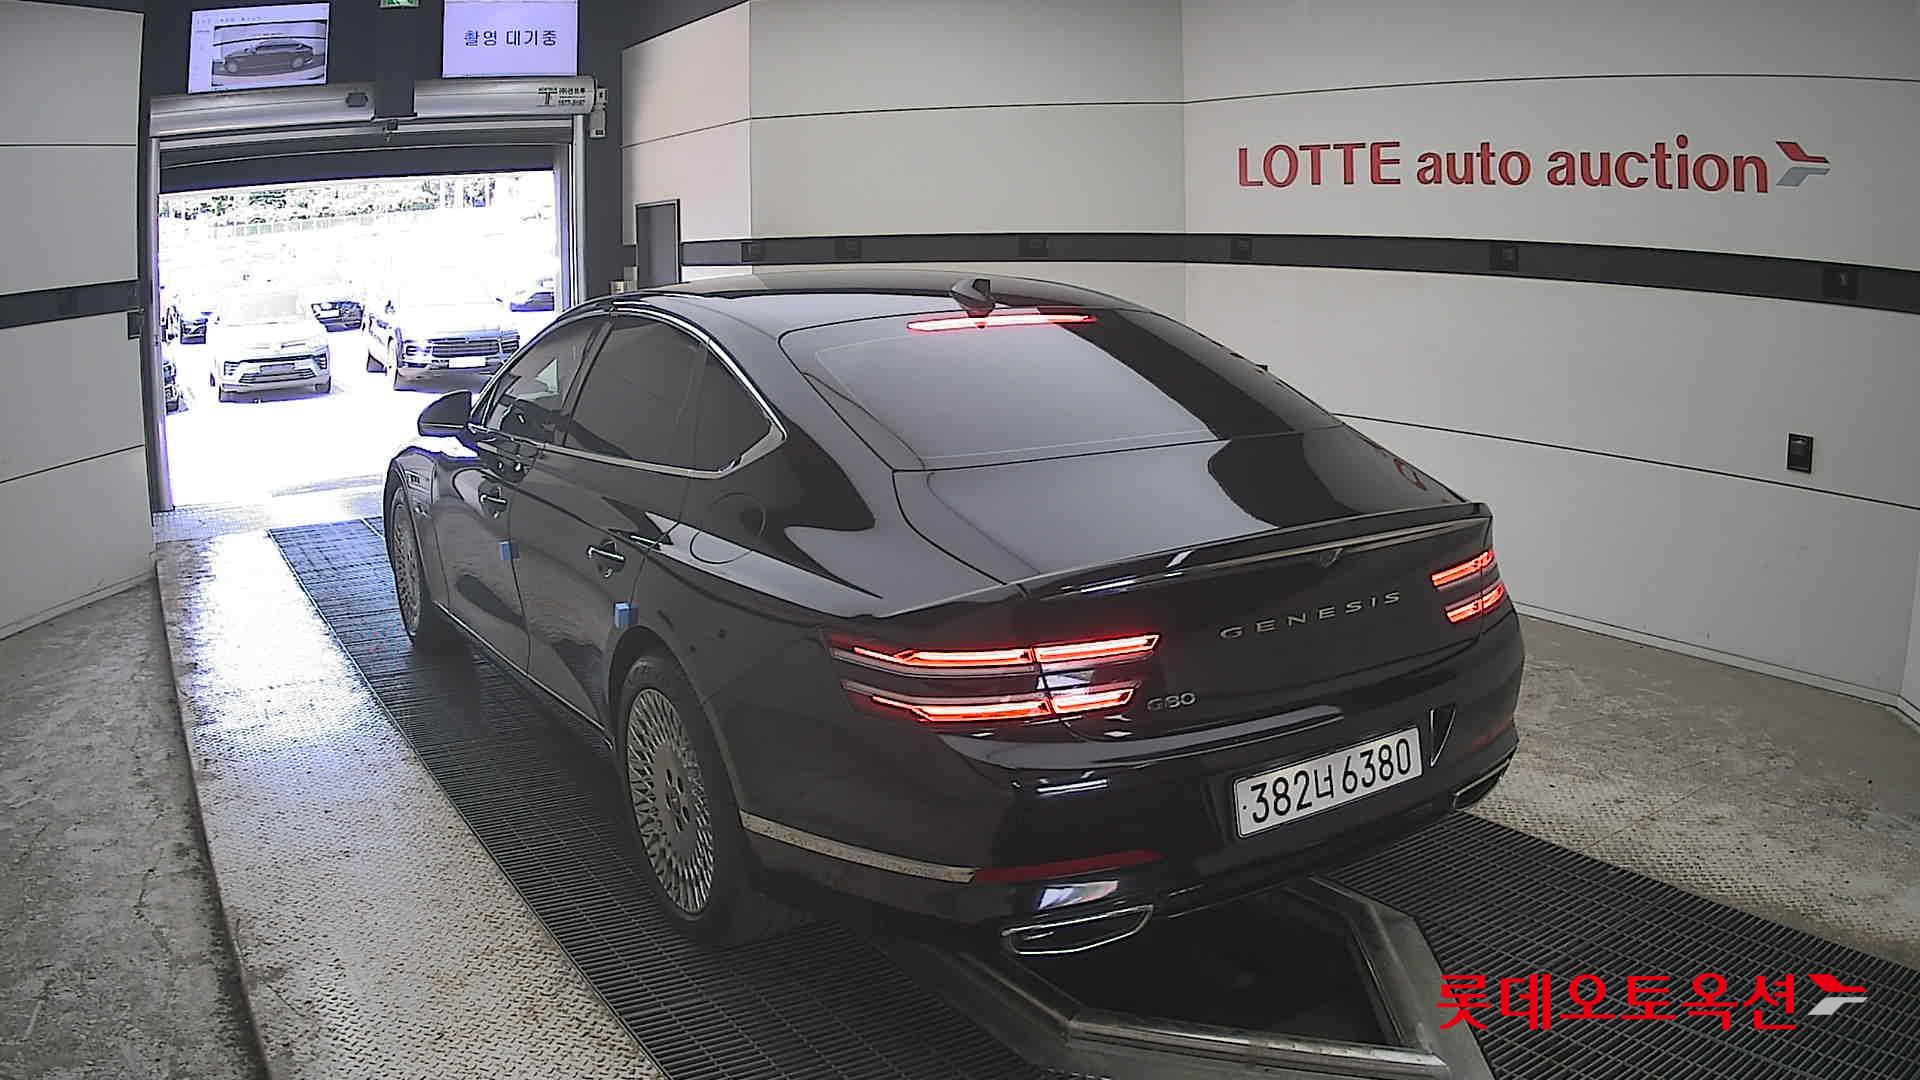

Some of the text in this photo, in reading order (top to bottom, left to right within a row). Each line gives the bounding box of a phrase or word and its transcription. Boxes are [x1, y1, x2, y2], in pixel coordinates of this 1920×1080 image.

[464, 29, 558, 47] 촬영 대기중
[1238, 134, 1769, 193] LOTTE auto auction
[1219, 591, 1401, 639] GENESIS
[1147, 692, 1196, 711] G80
